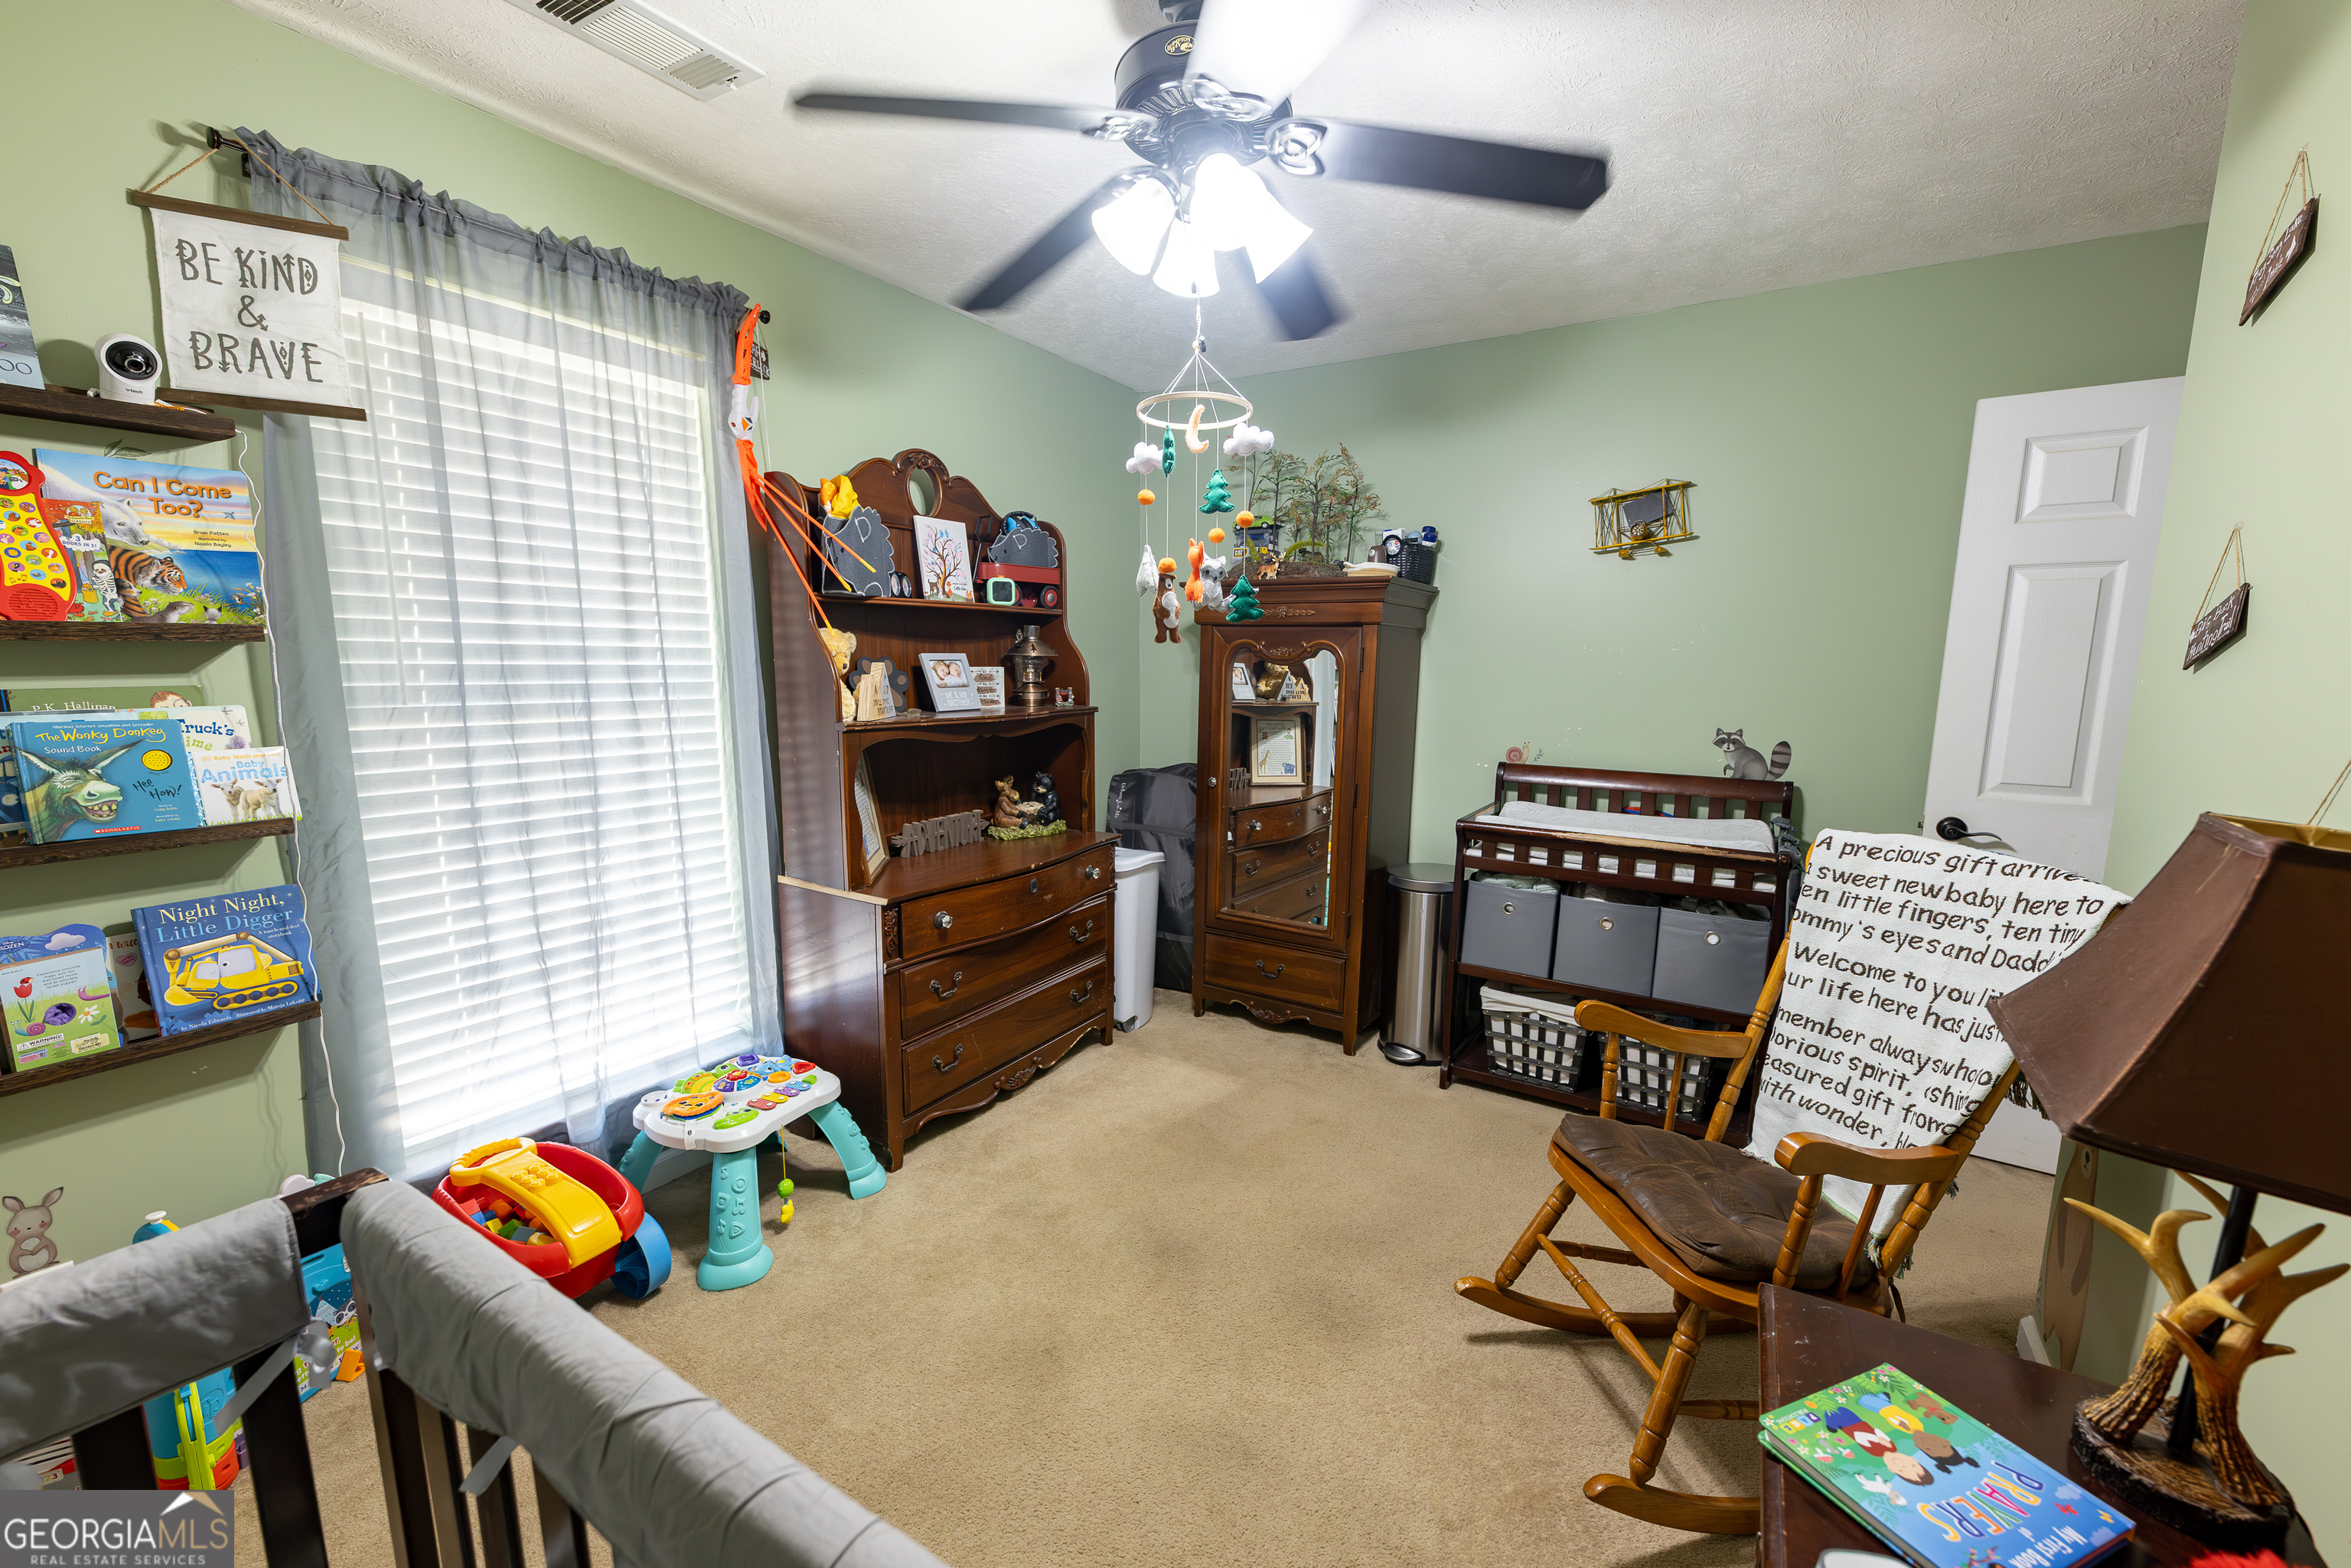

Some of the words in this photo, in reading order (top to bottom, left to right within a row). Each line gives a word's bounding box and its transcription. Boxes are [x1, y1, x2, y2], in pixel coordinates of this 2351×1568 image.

[175, 239, 223, 285] BE
[237, 295, 268, 331] &
[189, 331, 324, 383] BRAVE
[93, 471, 144, 493] Can
[151, 477, 158, 494] I
[165, 479, 232, 499] Come
[148, 497, 204, 519] Too?
[35, 732, 62, 742] The
[60, 729, 109, 745] Wonky
[113, 727, 166, 743] Donkey
[44, 745, 76, 755] Sound
[201, 763, 287, 784] Animals
[236, 760, 264, 768] Baby
[132, 778, 154, 793] Hee
[1815, 836, 1833, 851] A
[1838, 842, 1942, 865] precious
[1942, 854, 1998, 877] gift
[1816, 866, 1891, 891] sweet
[1893, 879, 1945, 899] new
[1944, 882, 2007, 918] baby
[2012, 891, 2069, 916] here
[2076, 895, 2105, 915] to
[158, 903, 218, 924] Night
[222, 893, 285, 914] Night,
[1837, 890, 1893, 915] little
[1898, 899, 1993, 941] fingers,
[2001, 920, 2043, 942] ten
[2049, 922, 2087, 951] tiny
[155, 921, 218, 944] Little
[223, 909, 293, 931] Digger
[263, 923, 301, 934] touch-and-feel
[268, 931, 293, 939] storybook
[1880, 929, 1942, 954] eyes
[1942, 944, 1991, 965] and
[1794, 941, 1896, 983] Welcome
[1903, 970, 1927, 992] to
[1929, 982, 1976, 1005] you
[188, 1020, 208, 1029] Nicola
[207, 1015, 232, 1025] Edwards
[236, 1008, 261, 1019] Illustrated
[267, 1002, 285, 1012] Mateja
[1785, 970, 1813, 989] ur
[1818, 977, 1864, 1004] life
[1867, 986, 1919, 1020] here
[1922, 1004, 1965, 1033] has
[29, 1035, 62, 1046] WARNING!
[1869, 1035, 1943, 1077] always
[1847, 1056, 1913, 1097] spirit,
[1850, 1087, 1896, 1117] gift
[1798, 1095, 1889, 1147] wonder,
[1916, 1459, 2046, 1543] PRAYERS
[2033, 1534, 2074, 1560] First
[2052, 1525, 2089, 1546] My
